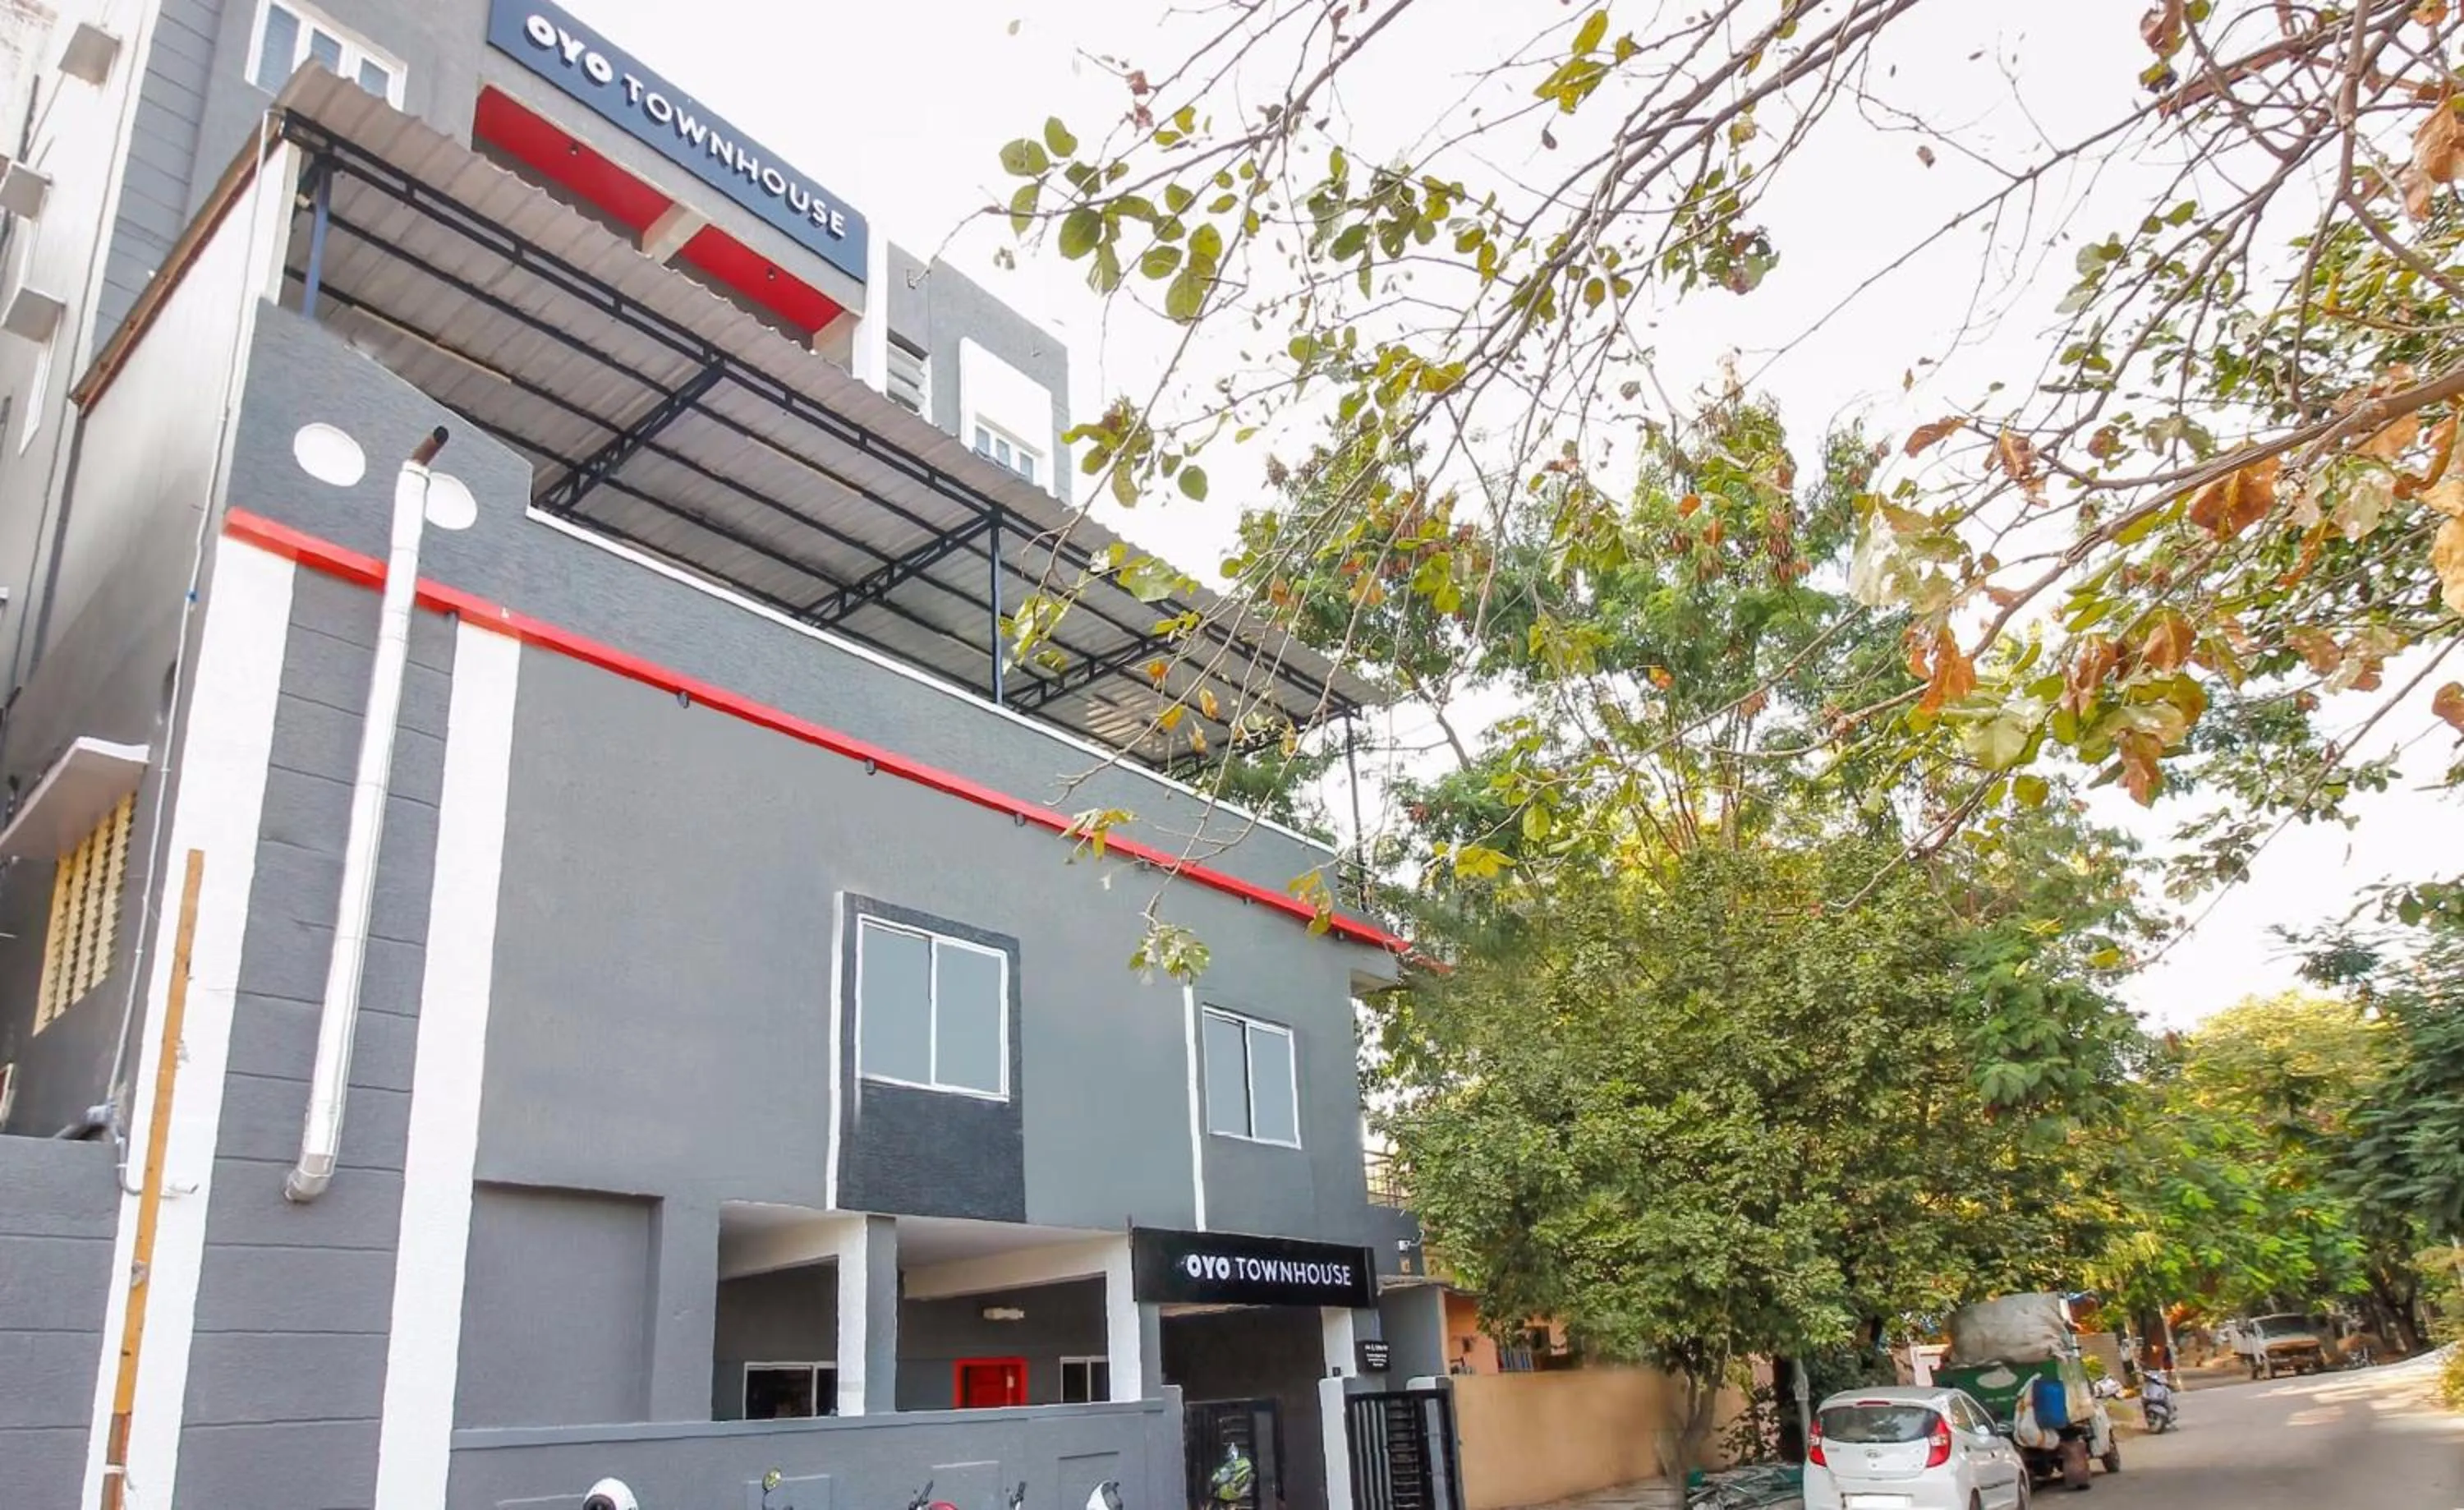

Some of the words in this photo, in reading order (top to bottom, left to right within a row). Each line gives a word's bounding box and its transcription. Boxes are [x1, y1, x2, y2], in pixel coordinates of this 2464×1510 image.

[526, 14, 614, 85] OYO
[622, 72, 847, 239] TOWNHOUSE
[1187, 1254, 1230, 1280] OYO
[1235, 1257, 1352, 1286] TOWNHOUSE
